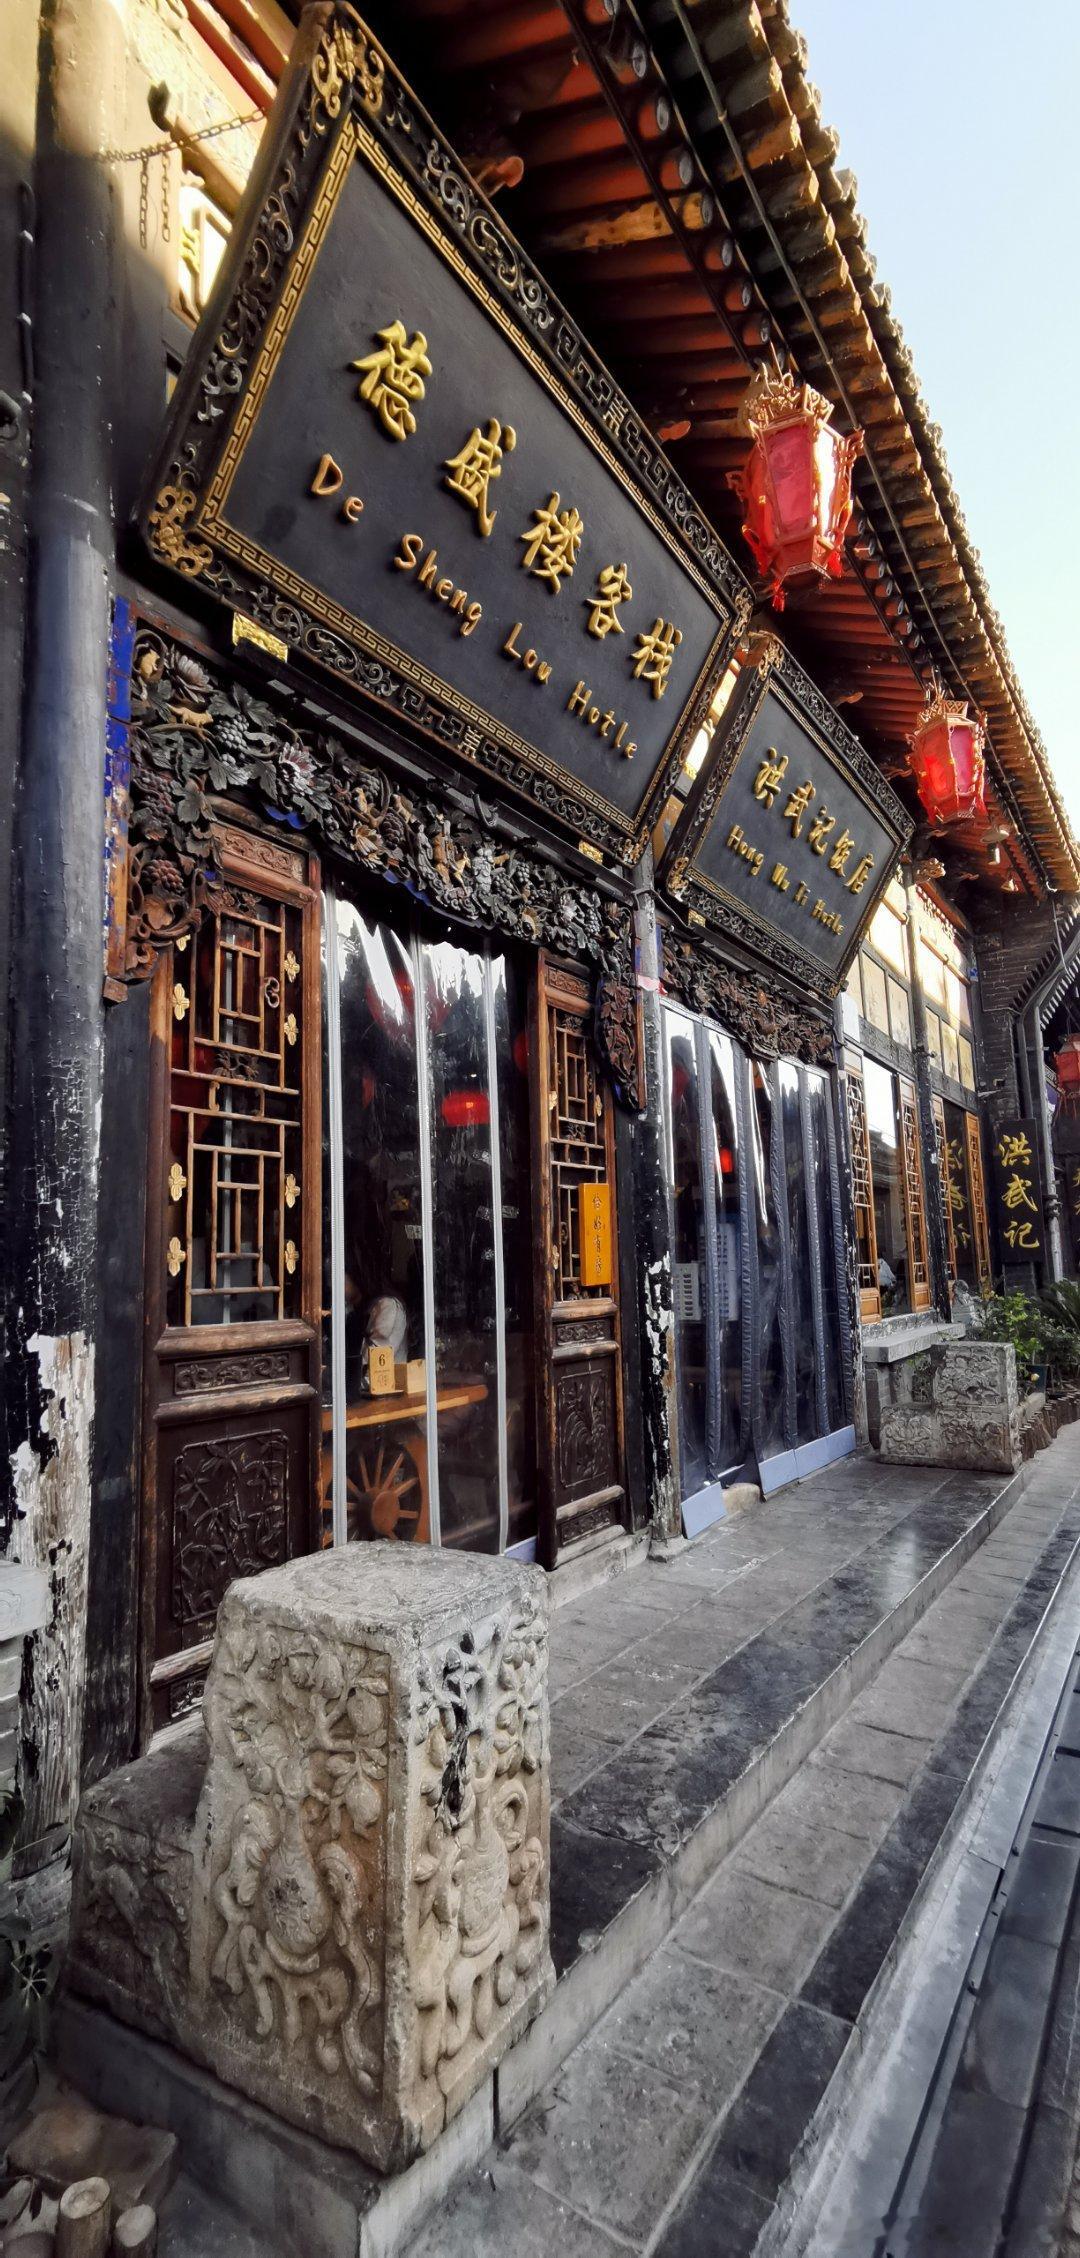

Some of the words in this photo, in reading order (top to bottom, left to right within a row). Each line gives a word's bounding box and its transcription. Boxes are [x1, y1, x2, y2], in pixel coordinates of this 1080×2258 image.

[351, 319, 683, 700] 德盛楼客栈
[311, 454, 365, 523] De
[393, 534, 483, 637] Sheng
[503, 622, 553, 684] Lou
[565, 680, 638, 760] Hotle
[726, 824, 765, 876] Hong
[771, 863, 790, 892] Wu
[754, 746, 875, 895] 洪武记饭店
[999, 1131, 1040, 1249] 洪武记
[378, 1353, 386, 1367] 6
